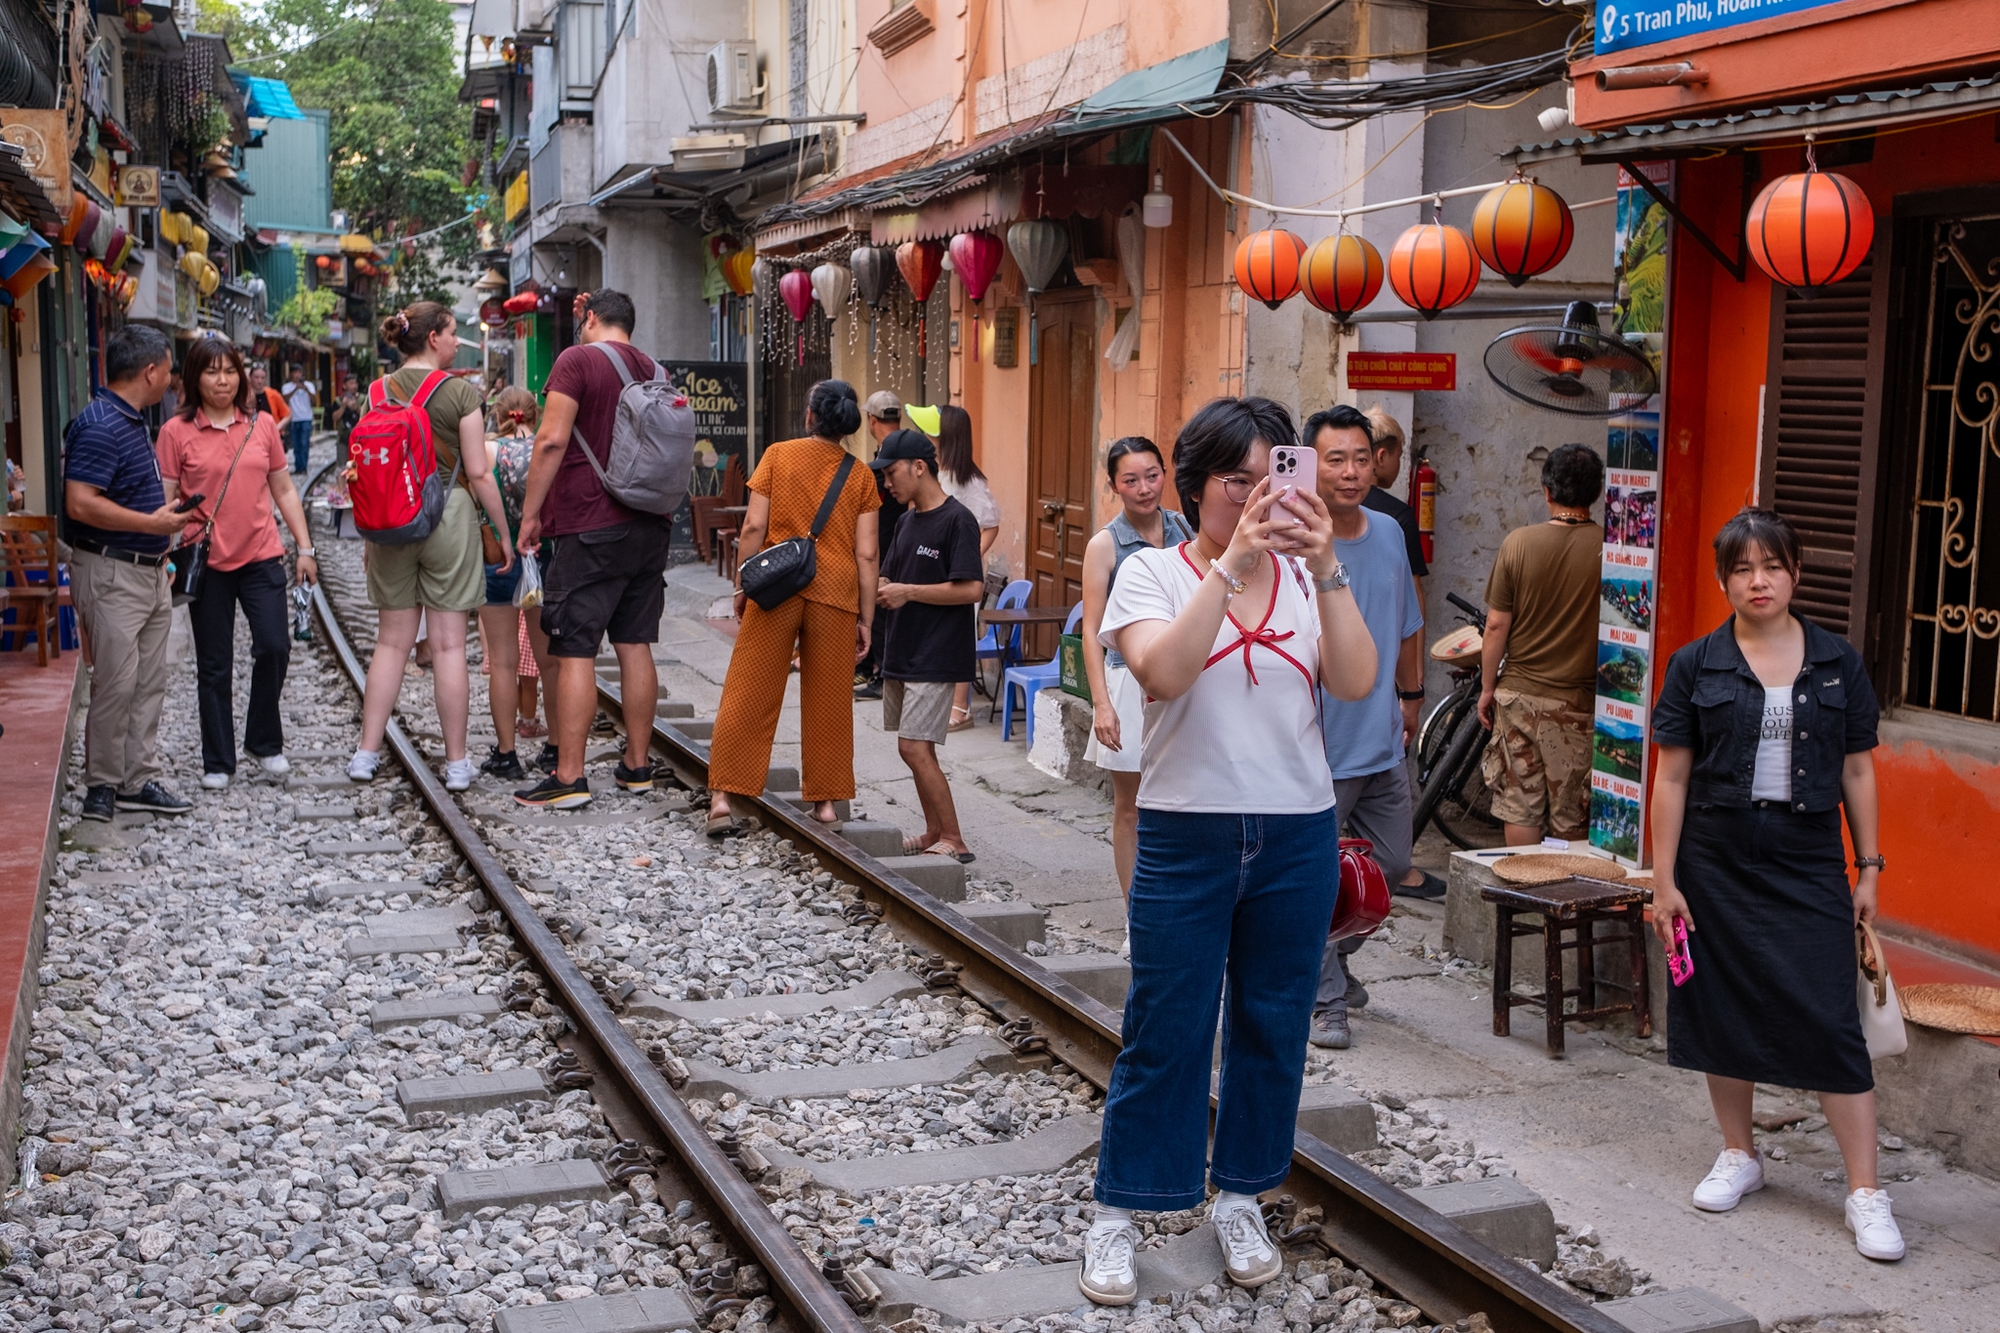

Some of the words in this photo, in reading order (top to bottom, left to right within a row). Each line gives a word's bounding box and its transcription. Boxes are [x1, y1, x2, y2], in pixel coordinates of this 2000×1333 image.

[1620, 14, 1629, 36] 5
[1634, 9, 1672, 33] Tran
[1676, 0, 1712, 25] Phu,
[686, 372, 723, 395] Ice
[1399, 376, 1432, 385] EQUIPMENT
[1611, 473, 1621, 484] BAC
[1629, 475, 1650, 487] MARKET
[1606, 551, 1613, 563] HA
[1633, 555, 1648, 567] LOOP
[1610, 629, 1620, 640] MAI
[1622, 631, 1637, 644] CHAU
[1062, 675, 1078, 688] SAIGON
[1606, 704, 1614, 715] PU
[1615, 706, 1633, 720] LUONG
[1593, 775, 1600, 787] BA
[1601, 778, 1609, 790] BE
[1613, 782, 1624, 795] BAN
[1625, 785, 1639, 799] GIOC
